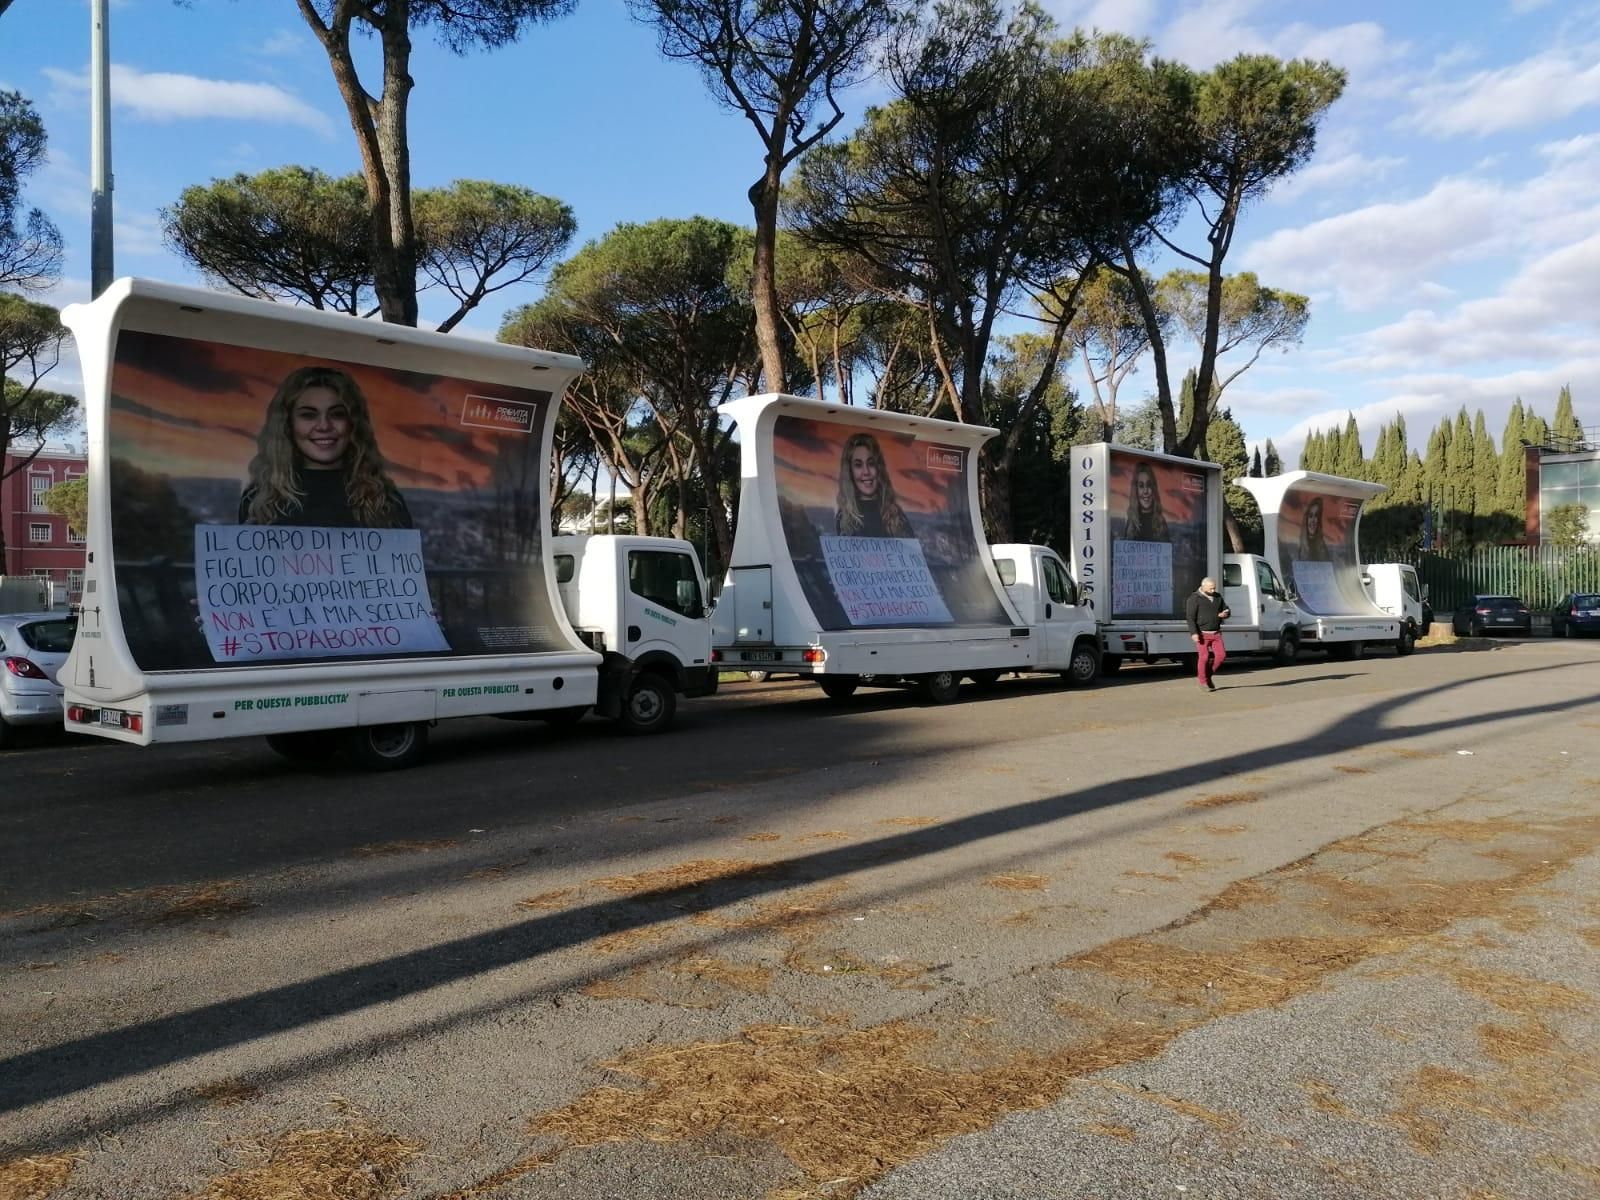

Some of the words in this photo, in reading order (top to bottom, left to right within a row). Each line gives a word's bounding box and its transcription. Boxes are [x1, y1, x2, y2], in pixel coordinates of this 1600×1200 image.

[205, 531, 228, 552] IL
[236, 529, 304, 551] CORPO
[311, 529, 331, 550] DI
[342, 530, 382, 551] MIO
[205, 555, 275, 578] FIGLIO
[283, 552, 336, 576] NON
[366, 553, 386, 575] IL
[391, 552, 422, 575] MIO
[212, 611, 255, 632] NON
[289, 608, 316, 626] LA
[323, 605, 362, 624] MIA
[366, 601, 427, 623] SCELTA
[218, 626, 401, 656] #STOPABORTO
[443, 688, 456, 697] PER
[458, 686, 481, 697] QUESTA
[234, 700, 253, 711] PER
[256, 698, 292, 710] QUESTA
